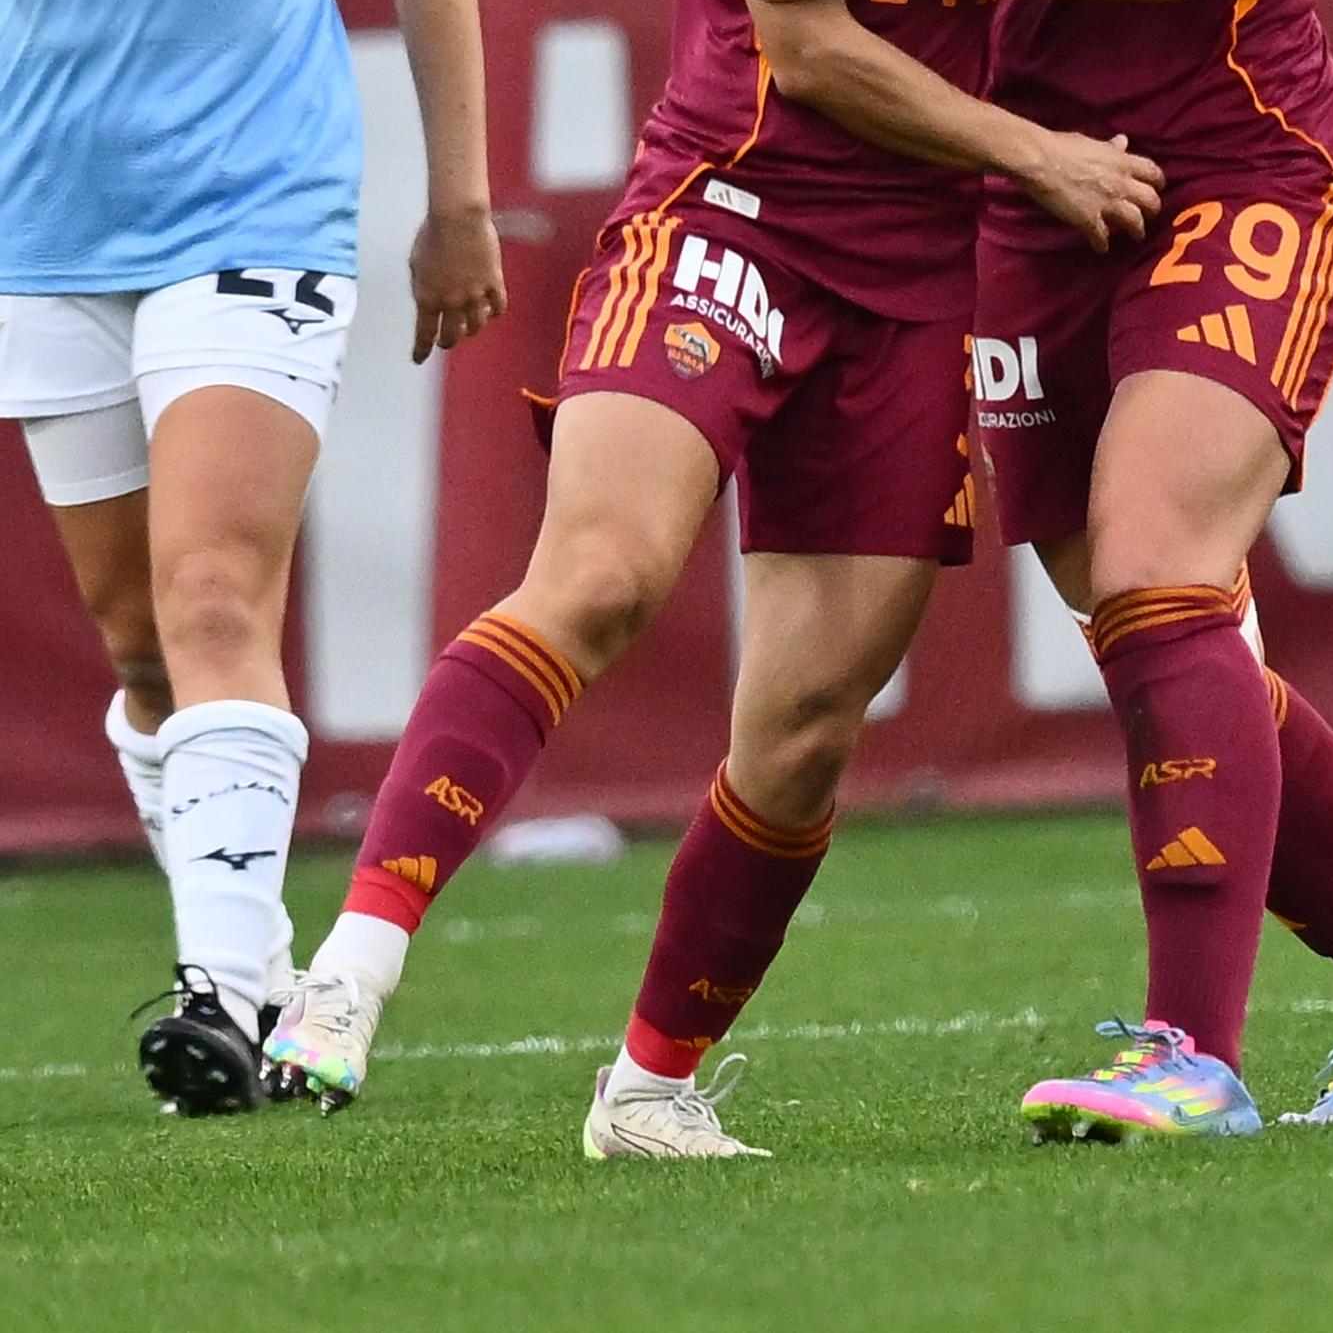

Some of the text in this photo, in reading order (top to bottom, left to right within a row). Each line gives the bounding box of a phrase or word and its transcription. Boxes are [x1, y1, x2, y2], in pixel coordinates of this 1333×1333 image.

[1149, 200, 1300, 300] 29
[670, 293, 775, 380] ASSICURAZION
[673, 234, 785, 366] HDI
[971, 336, 1045, 401] DI
[424, 775, 484, 826] ASR
[1140, 757, 1217, 788] ASR
